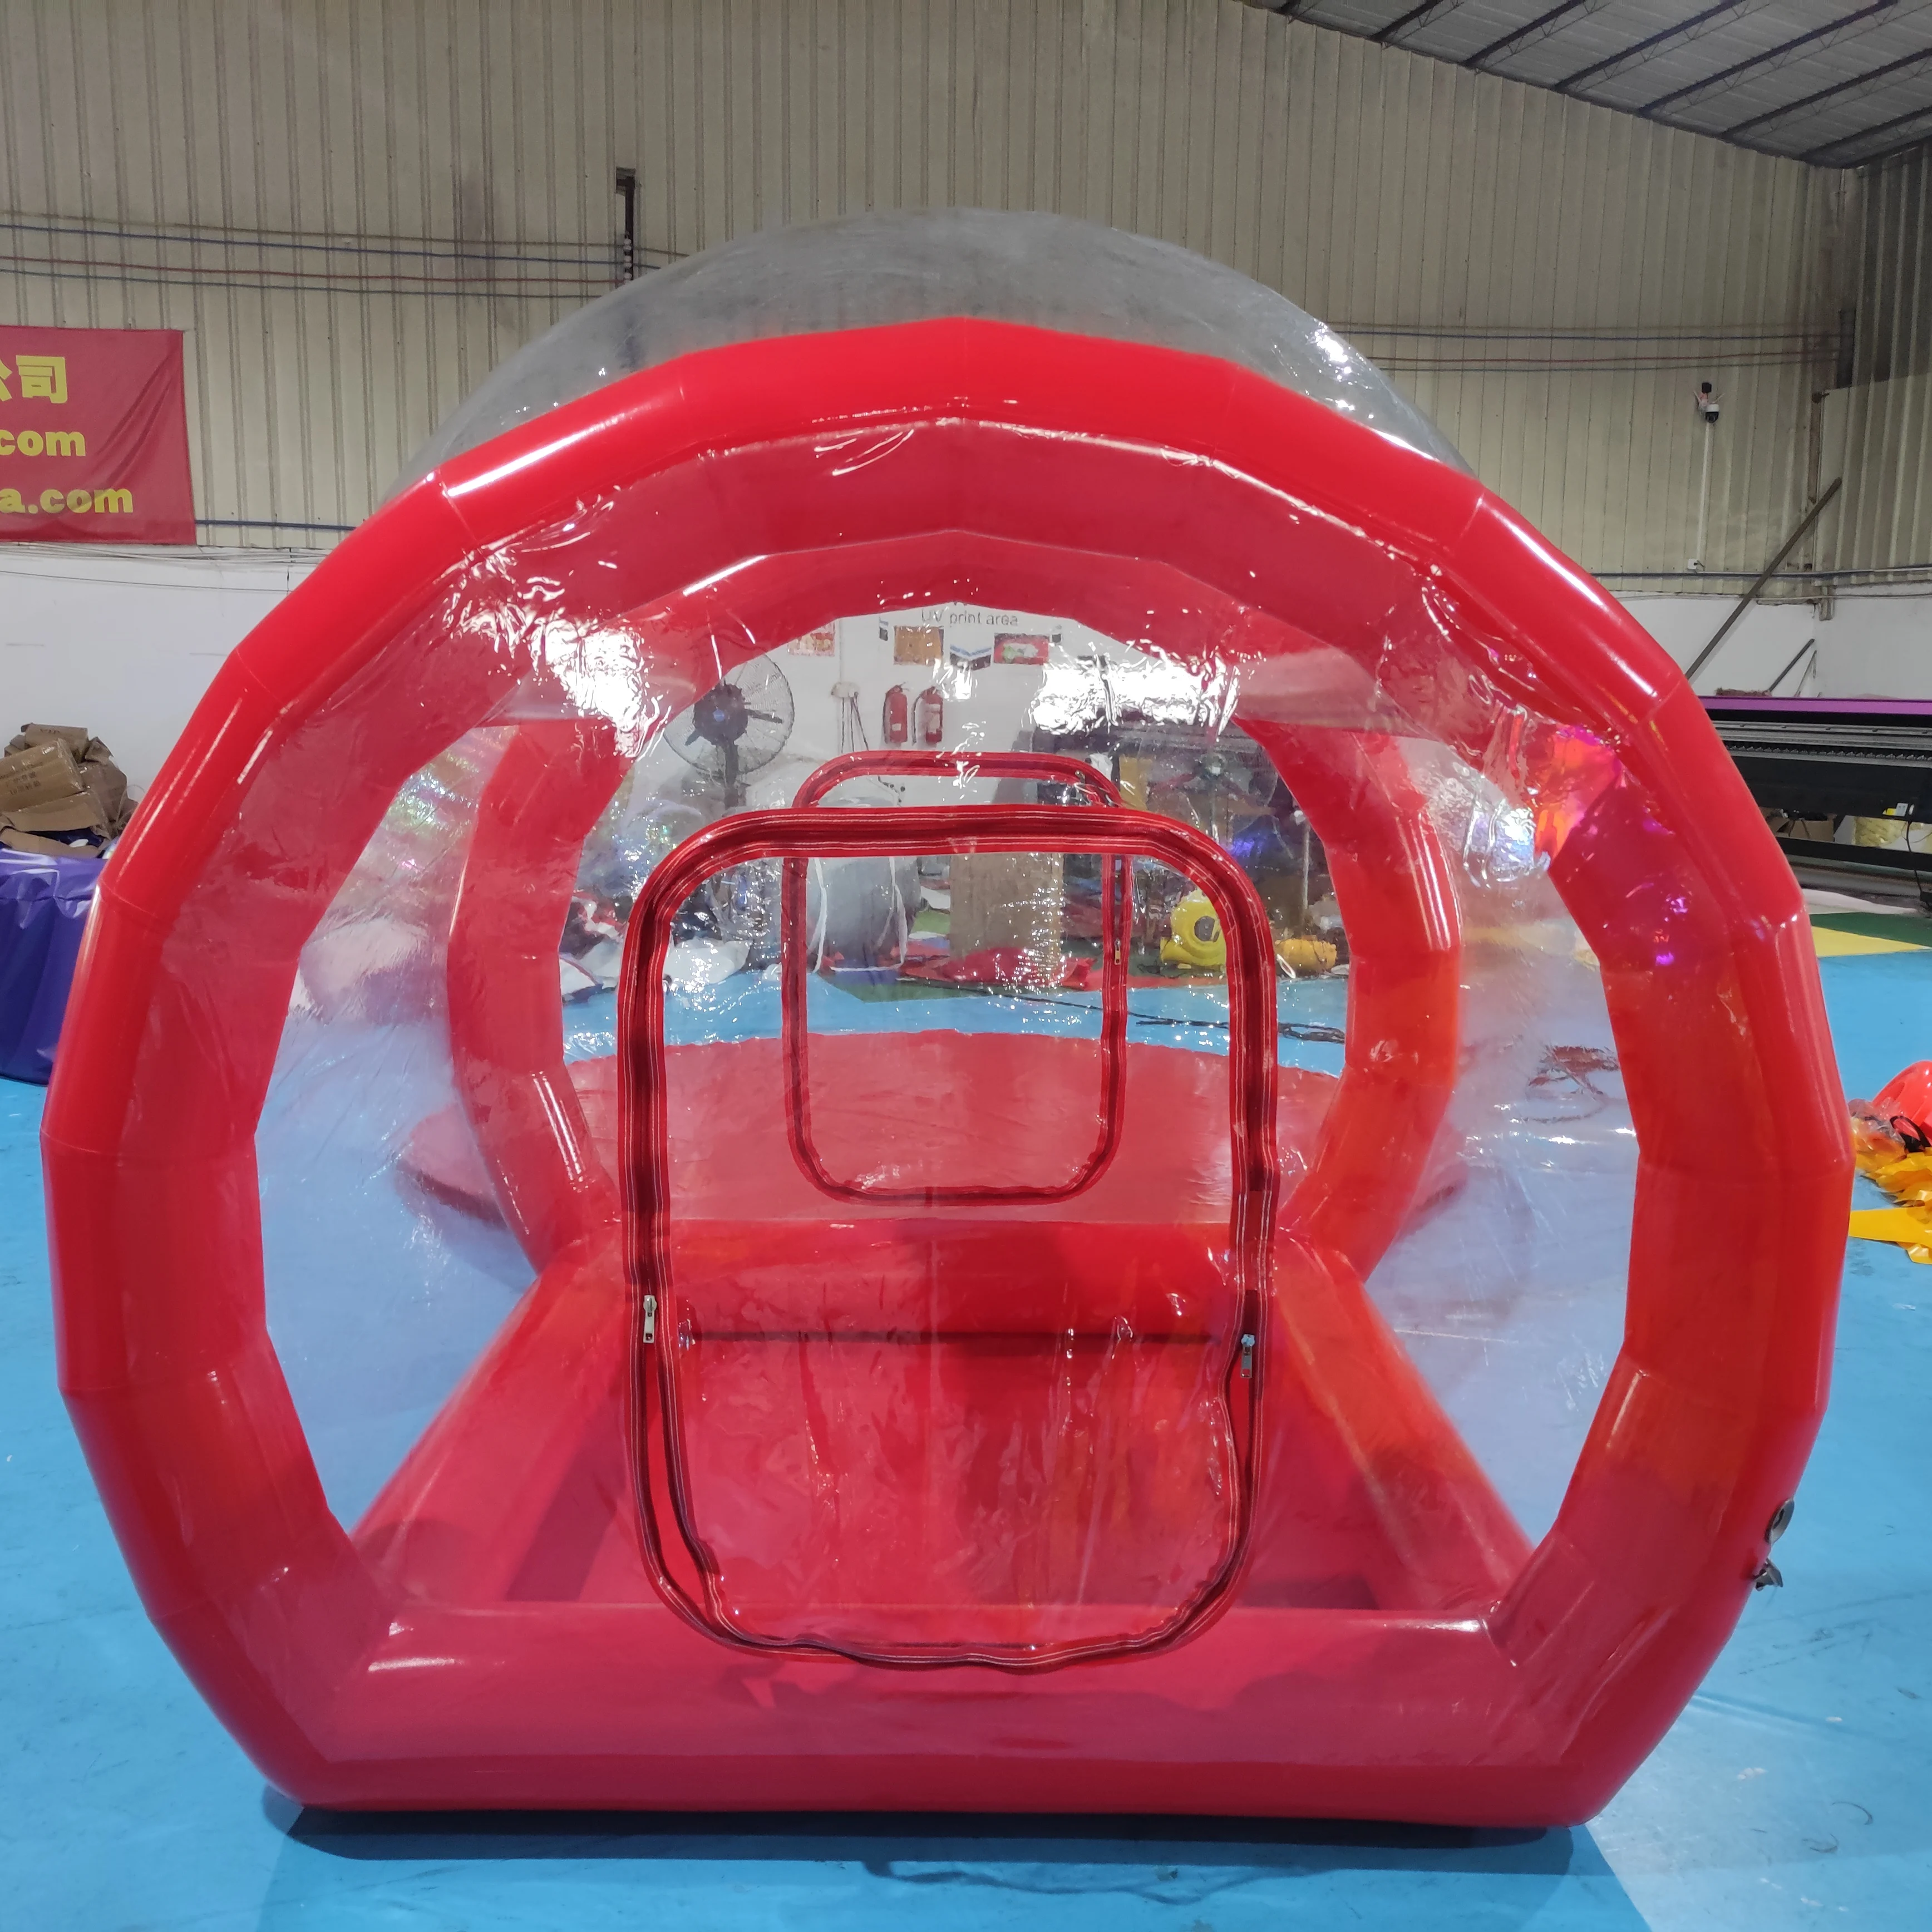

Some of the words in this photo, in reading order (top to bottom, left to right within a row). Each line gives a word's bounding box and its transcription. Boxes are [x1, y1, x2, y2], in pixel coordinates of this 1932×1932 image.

[0, 355, 68, 403] 司
[0, 488, 133, 514] a.com
[921, 609, 944, 622] UV
[949, 610, 982, 628] print
[986, 614, 1018, 627] area
